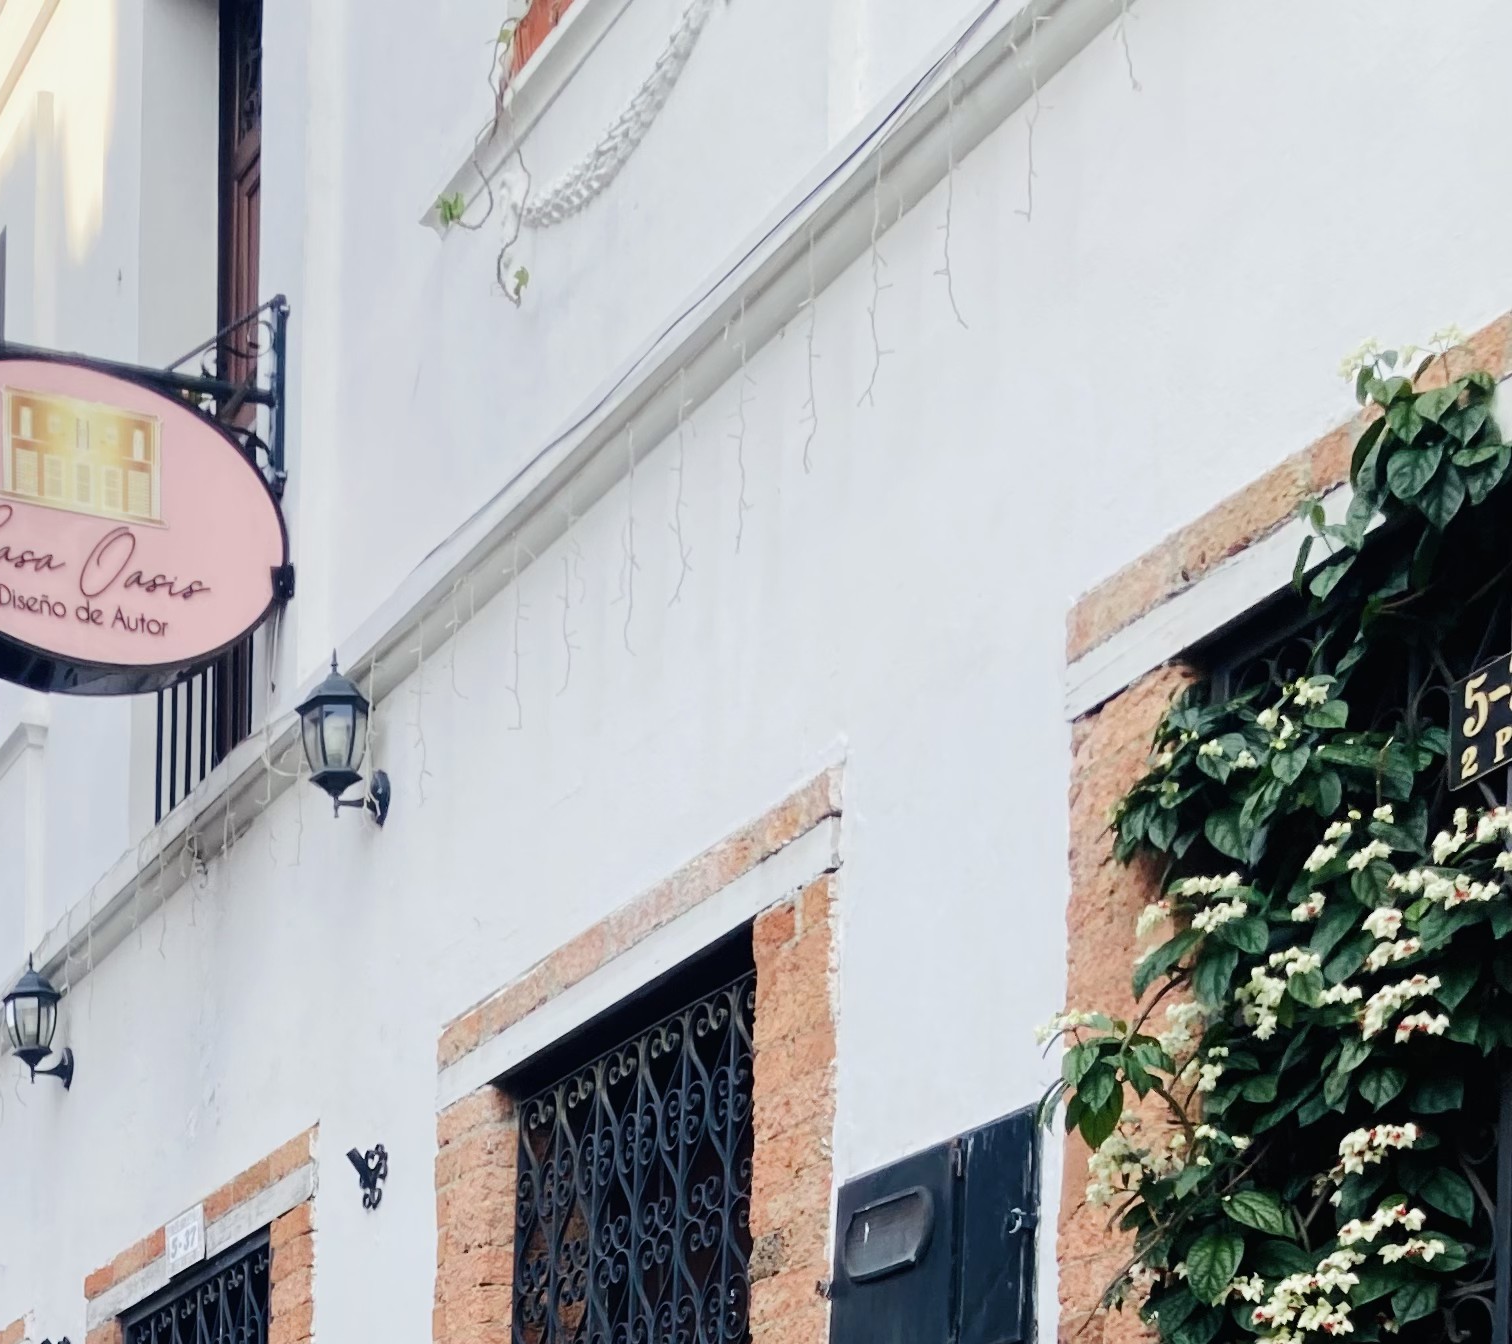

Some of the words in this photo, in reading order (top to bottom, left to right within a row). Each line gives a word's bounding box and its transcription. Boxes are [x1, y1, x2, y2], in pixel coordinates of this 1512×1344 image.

[79, 526, 211, 600] Oasis
[75, 599, 103, 625] de
[111, 605, 169, 637] Autor
[1462, 658, 1512, 738] 5-
[1461, 745, 1478, 780] 2
